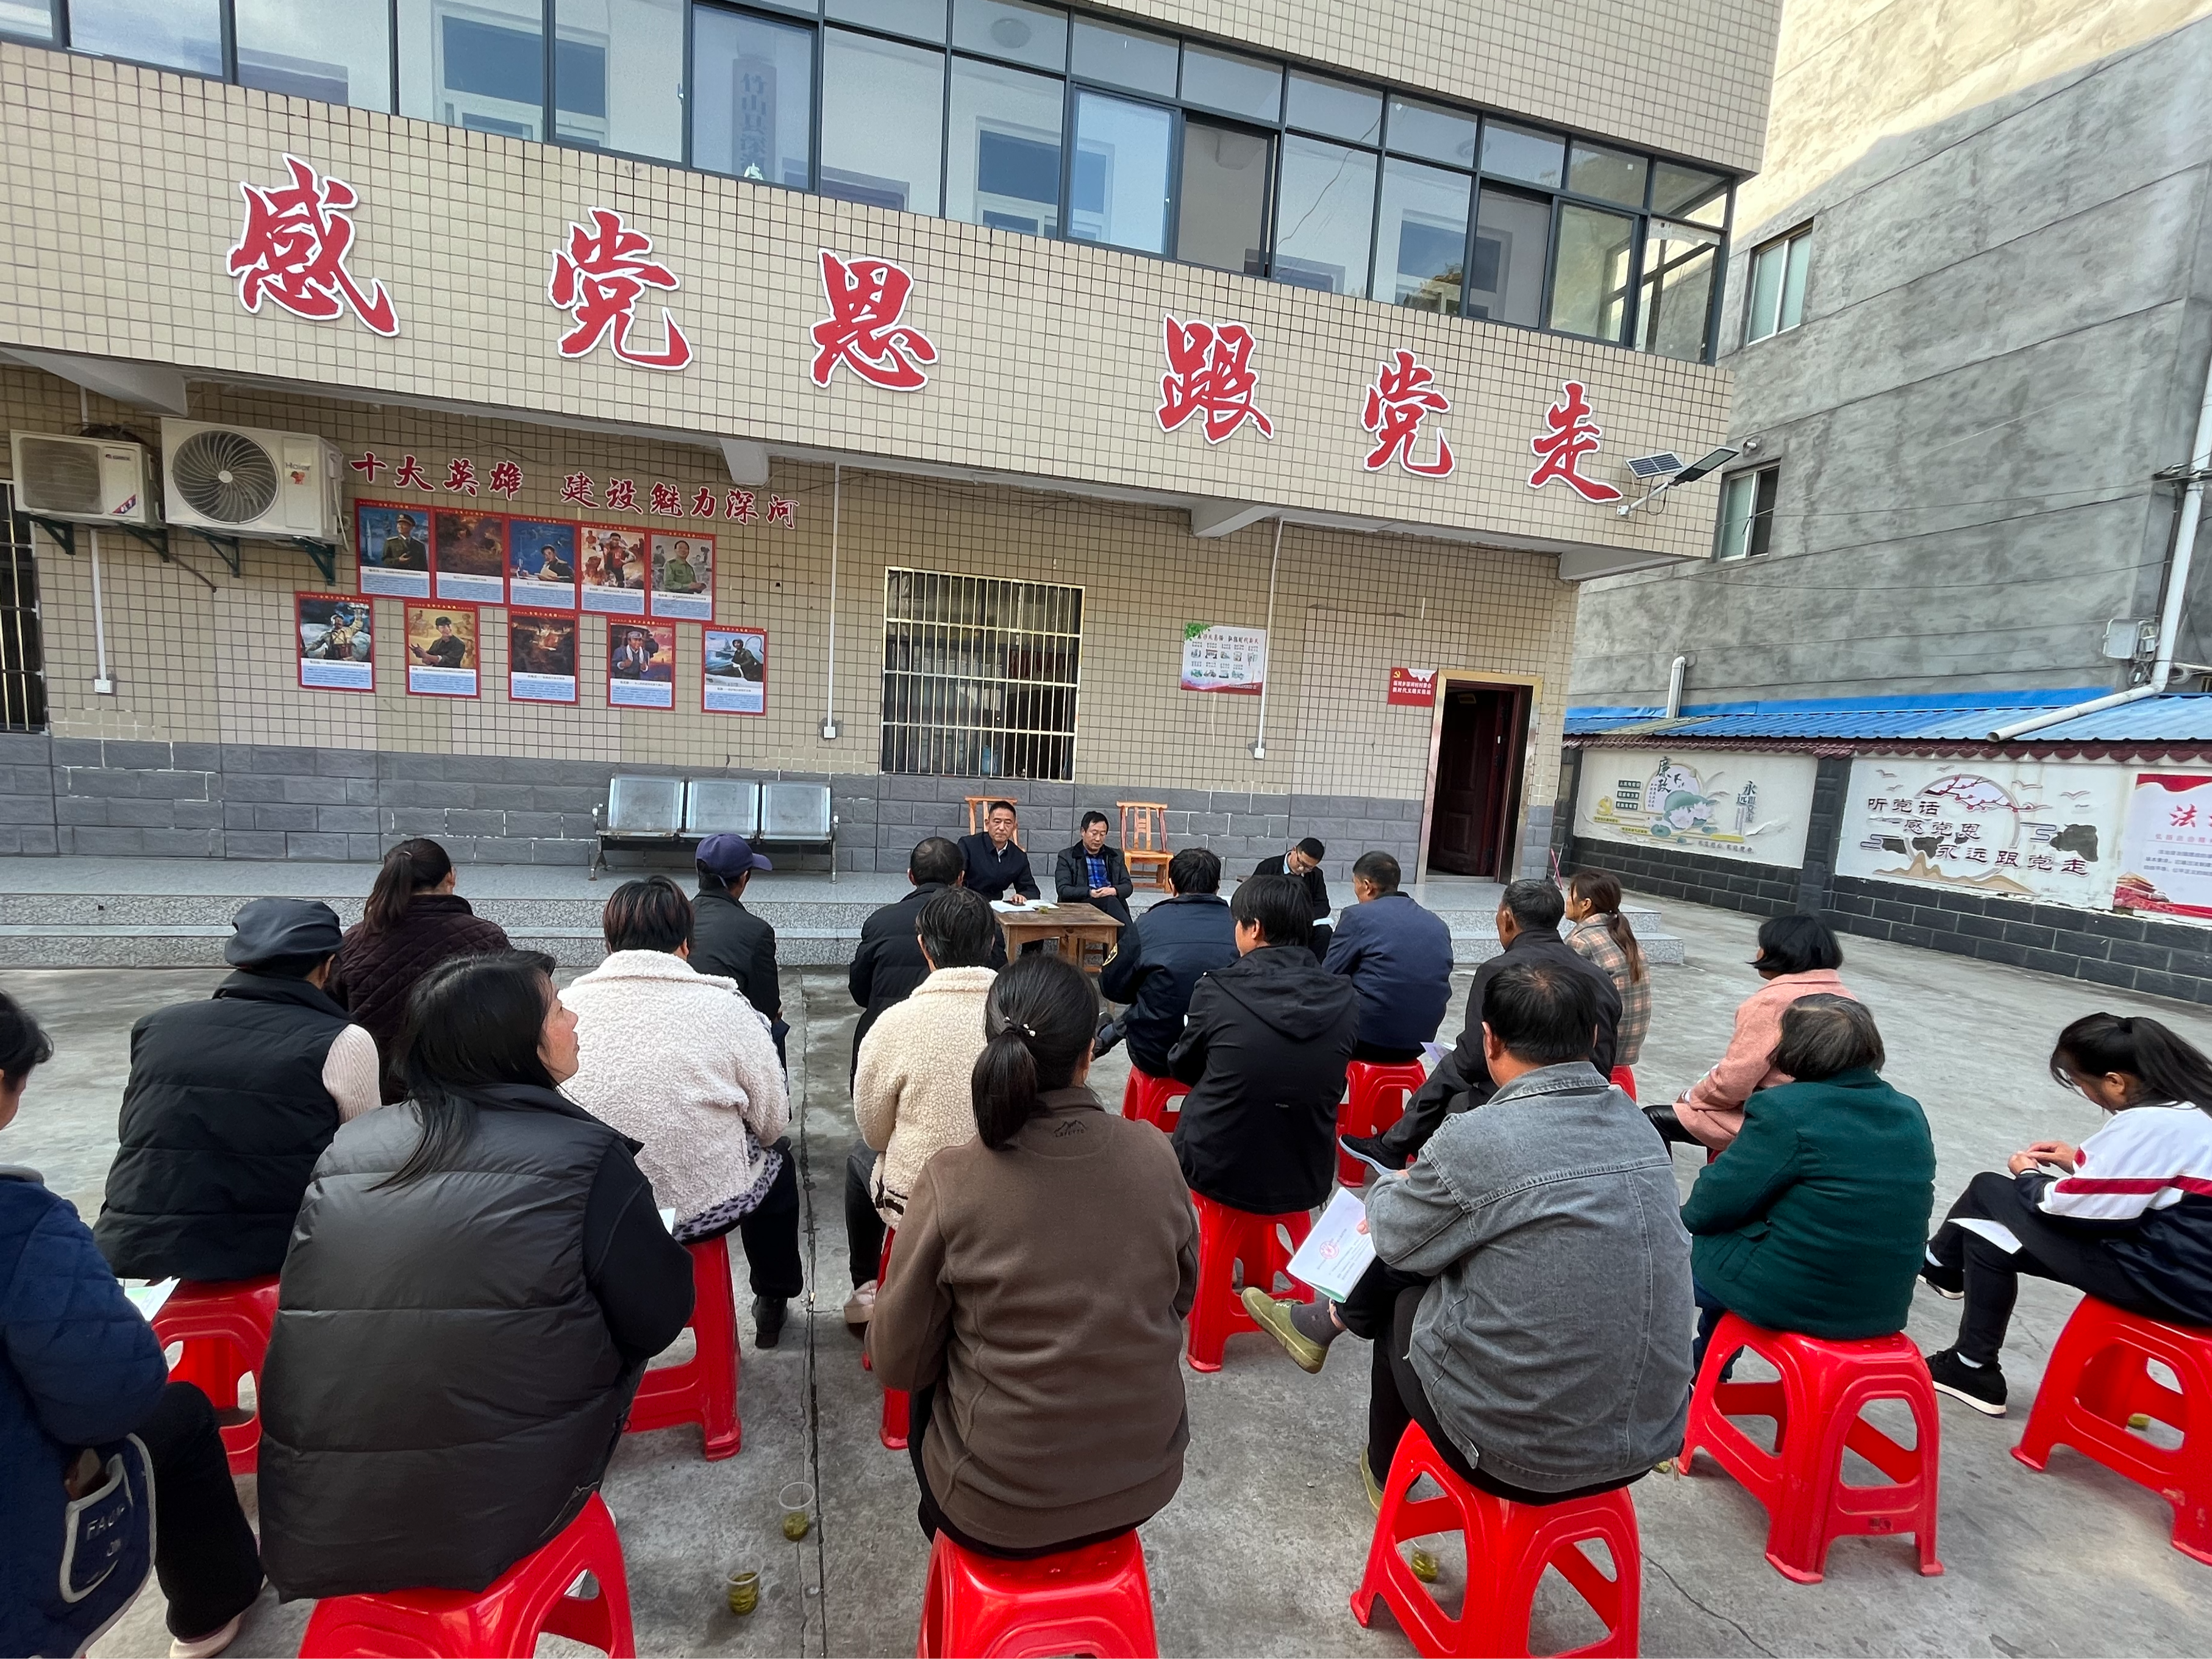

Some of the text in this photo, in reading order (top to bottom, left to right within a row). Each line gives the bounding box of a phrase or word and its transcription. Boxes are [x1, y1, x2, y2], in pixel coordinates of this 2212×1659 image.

[226, 152, 1624, 504] 感党恩 跟党走
[350, 451, 800, 530] 十大英雄 建设魅力深河
[1868, 796, 1941, 816] 听党话
[1903, 819, 1981, 840] 感党恩
[1935, 843, 2090, 876] 永远跟党走
